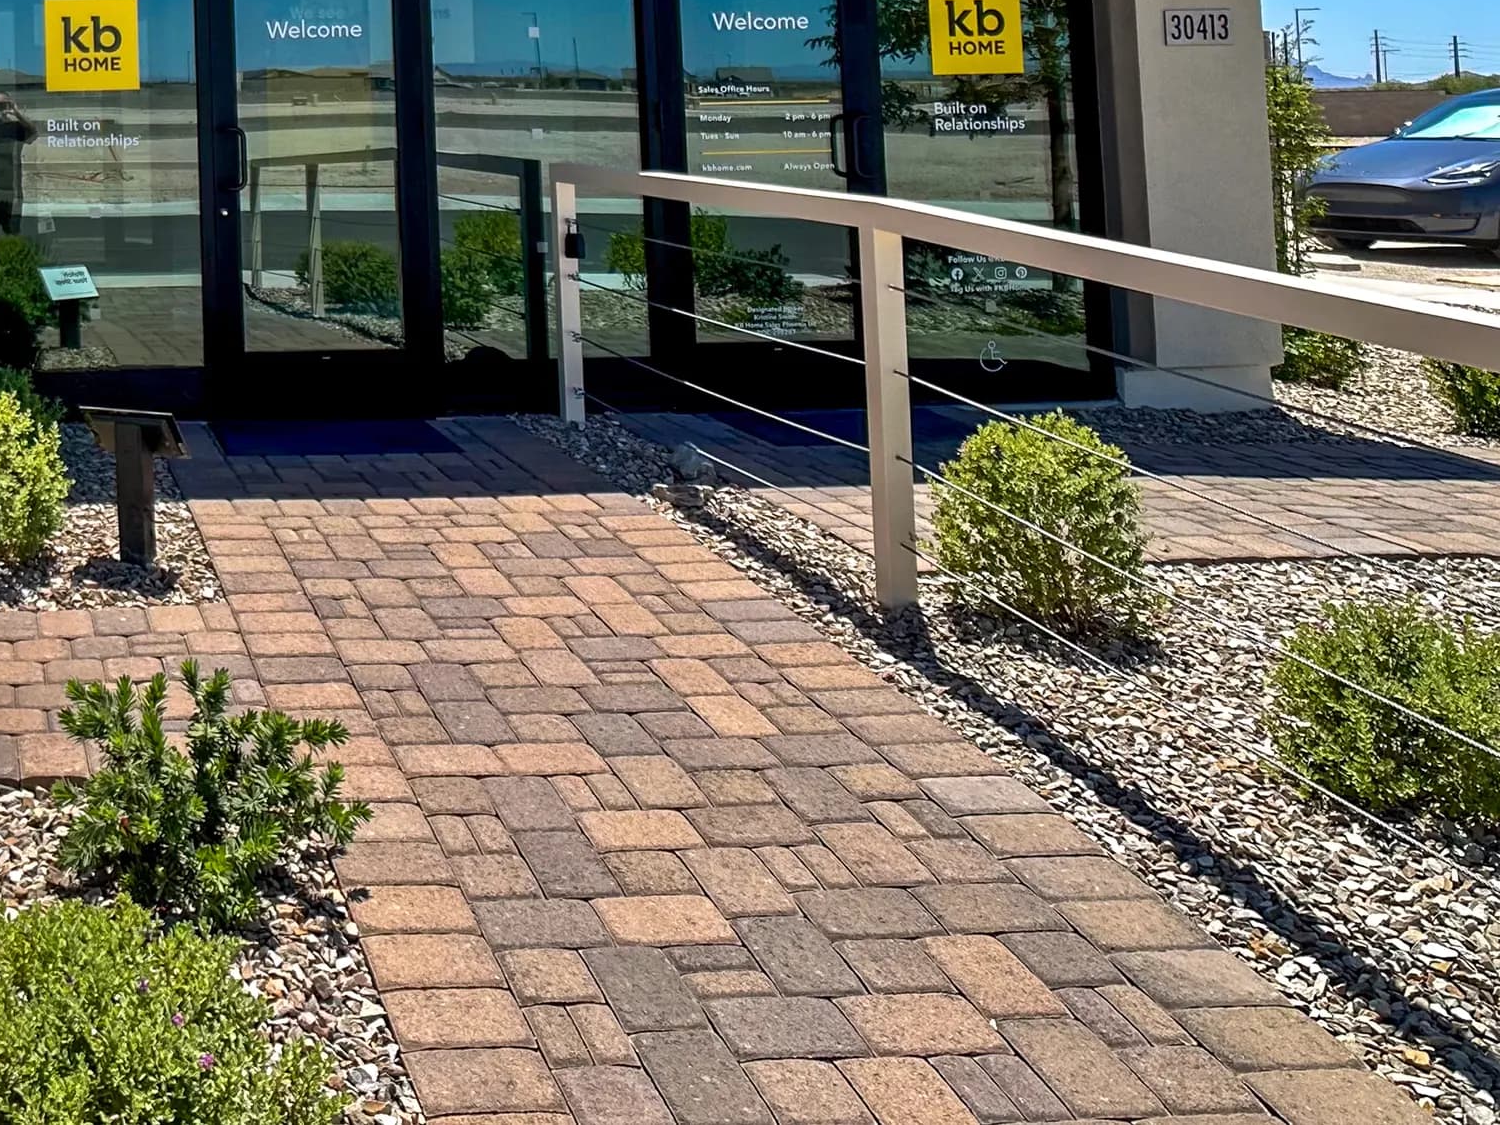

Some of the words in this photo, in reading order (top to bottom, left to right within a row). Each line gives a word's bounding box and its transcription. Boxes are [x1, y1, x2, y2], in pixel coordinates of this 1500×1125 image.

[712, 11, 809, 31] Welcome
[945, 0, 1005, 37] kb
[266, 19, 362, 39] Welcome
[1171, 14, 1229, 40] 30413
[61, 16, 122, 53] kb
[949, 40, 1005, 55] HOME
[64, 57, 121, 72] HOME
[698, 86, 718, 94] Sales
[720, 86, 744, 94] Office
[746, 85, 770, 93] Hours
[933, 102, 966, 114] Built
[969, 104, 987, 114] on
[47, 119, 78, 131] Built
[83, 120, 100, 131] on
[700, 115, 732, 123] Monday
[792, 114, 805, 122] pm
[818, 113, 831, 121] pm
[935, 117, 1026, 132] Relationships
[47, 134, 140, 148] Relationships
[725, 132, 740, 140] Sun
[783, 131, 793, 139] 10
[819, 132, 831, 140] pm
[702, 164, 752, 172] kbhome.com
[784, 163, 811, 171] Always
[813, 162, 835, 170] Open
[948, 255, 975, 263] Follow
[976, 255, 987, 263] Us
[975, 284, 992, 292] with
